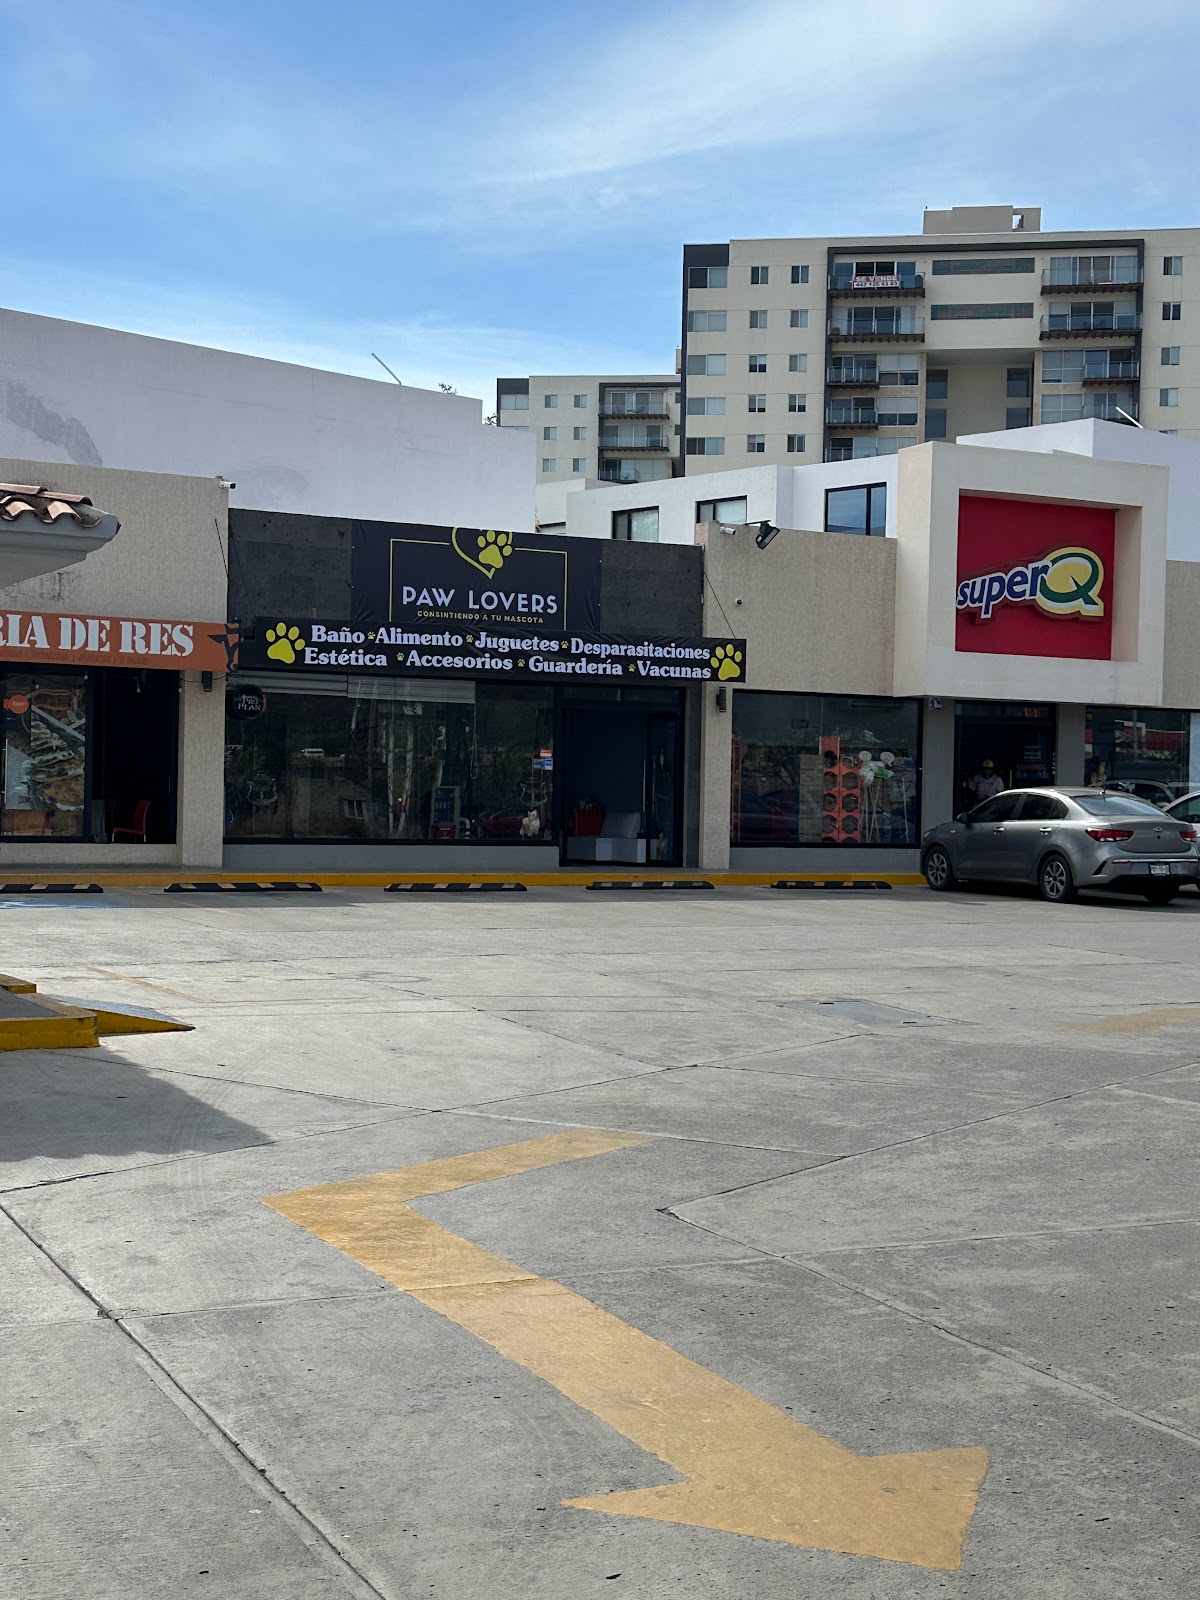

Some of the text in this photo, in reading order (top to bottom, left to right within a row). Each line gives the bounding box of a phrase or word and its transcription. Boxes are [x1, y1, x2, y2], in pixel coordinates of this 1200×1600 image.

[402, 586, 558, 614] PAW LOVERS
[417, 611, 480, 620] CONSINTIENDO
[504, 615, 544, 624] MASCOTA
[0, 614, 194, 657] IA DE RES
[311, 625, 711, 659] Baño Alimento Juguetes Desparasitaciones
[304, 647, 712, 679] Estética Accesorios Guardería Vacunas
